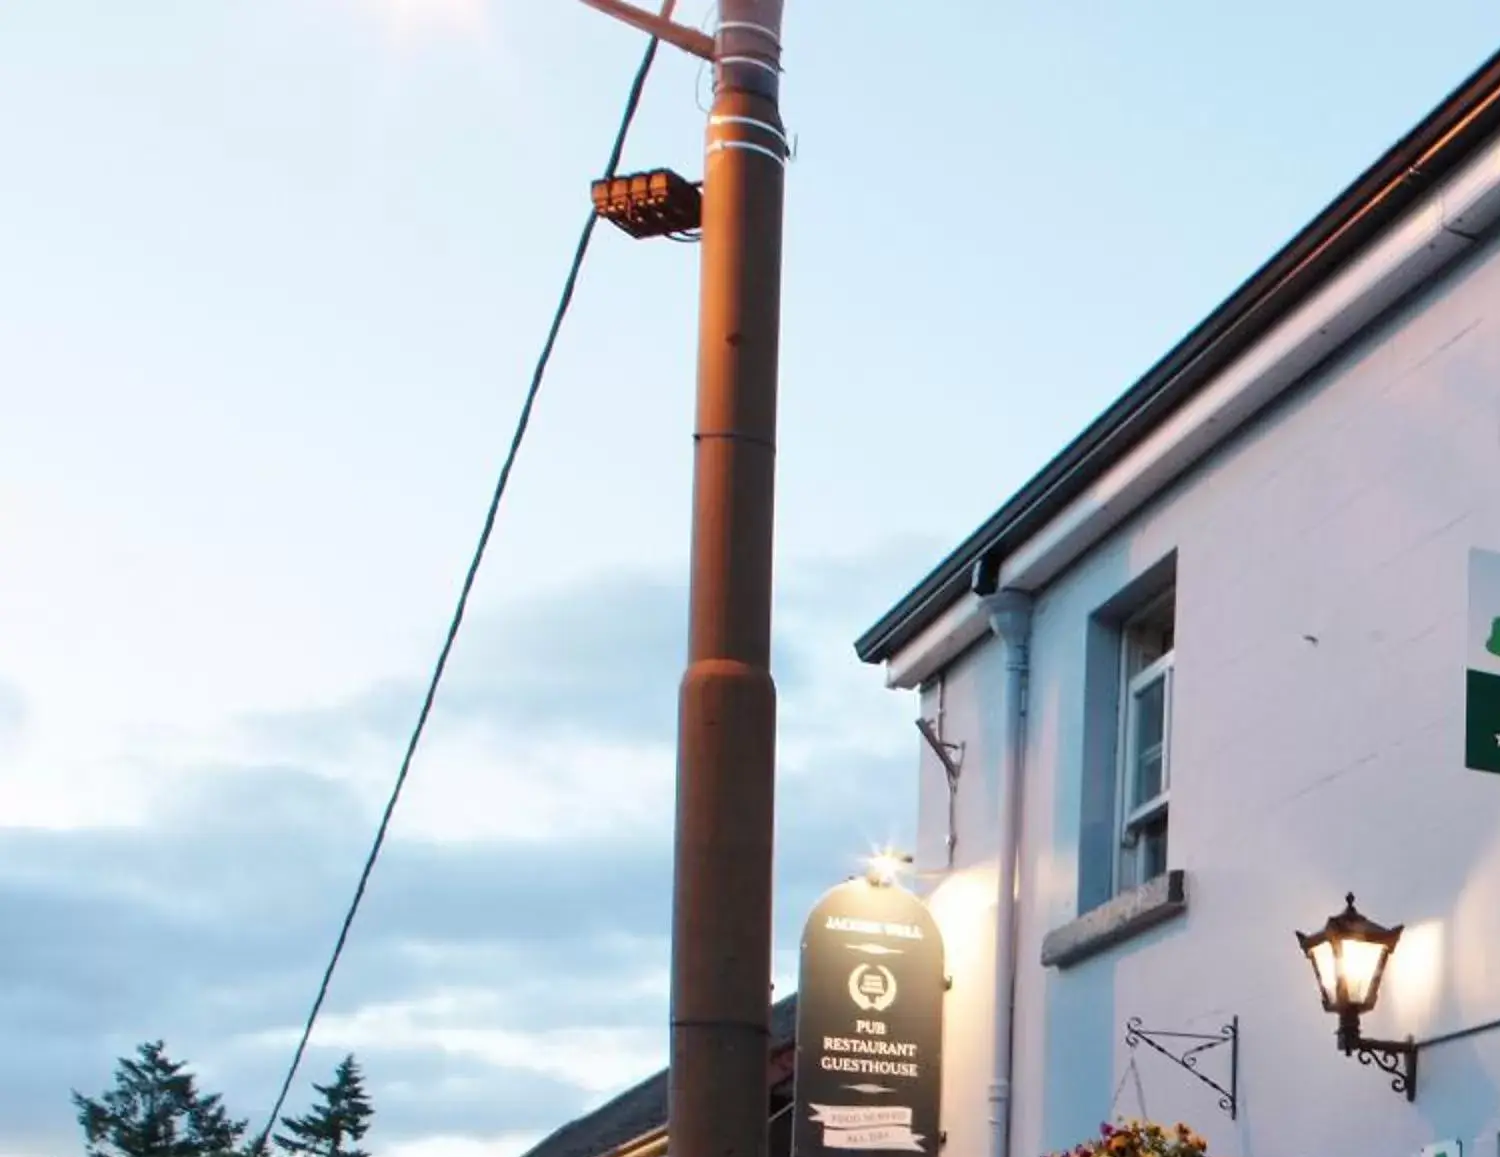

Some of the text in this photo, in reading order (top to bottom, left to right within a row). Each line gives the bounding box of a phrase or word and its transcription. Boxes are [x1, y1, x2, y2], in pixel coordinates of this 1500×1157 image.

[856, 1020, 886, 1035] PUB
[823, 1037, 918, 1056] RESTAURANT
[820, 1056, 918, 1077] GUESTHOUSE
